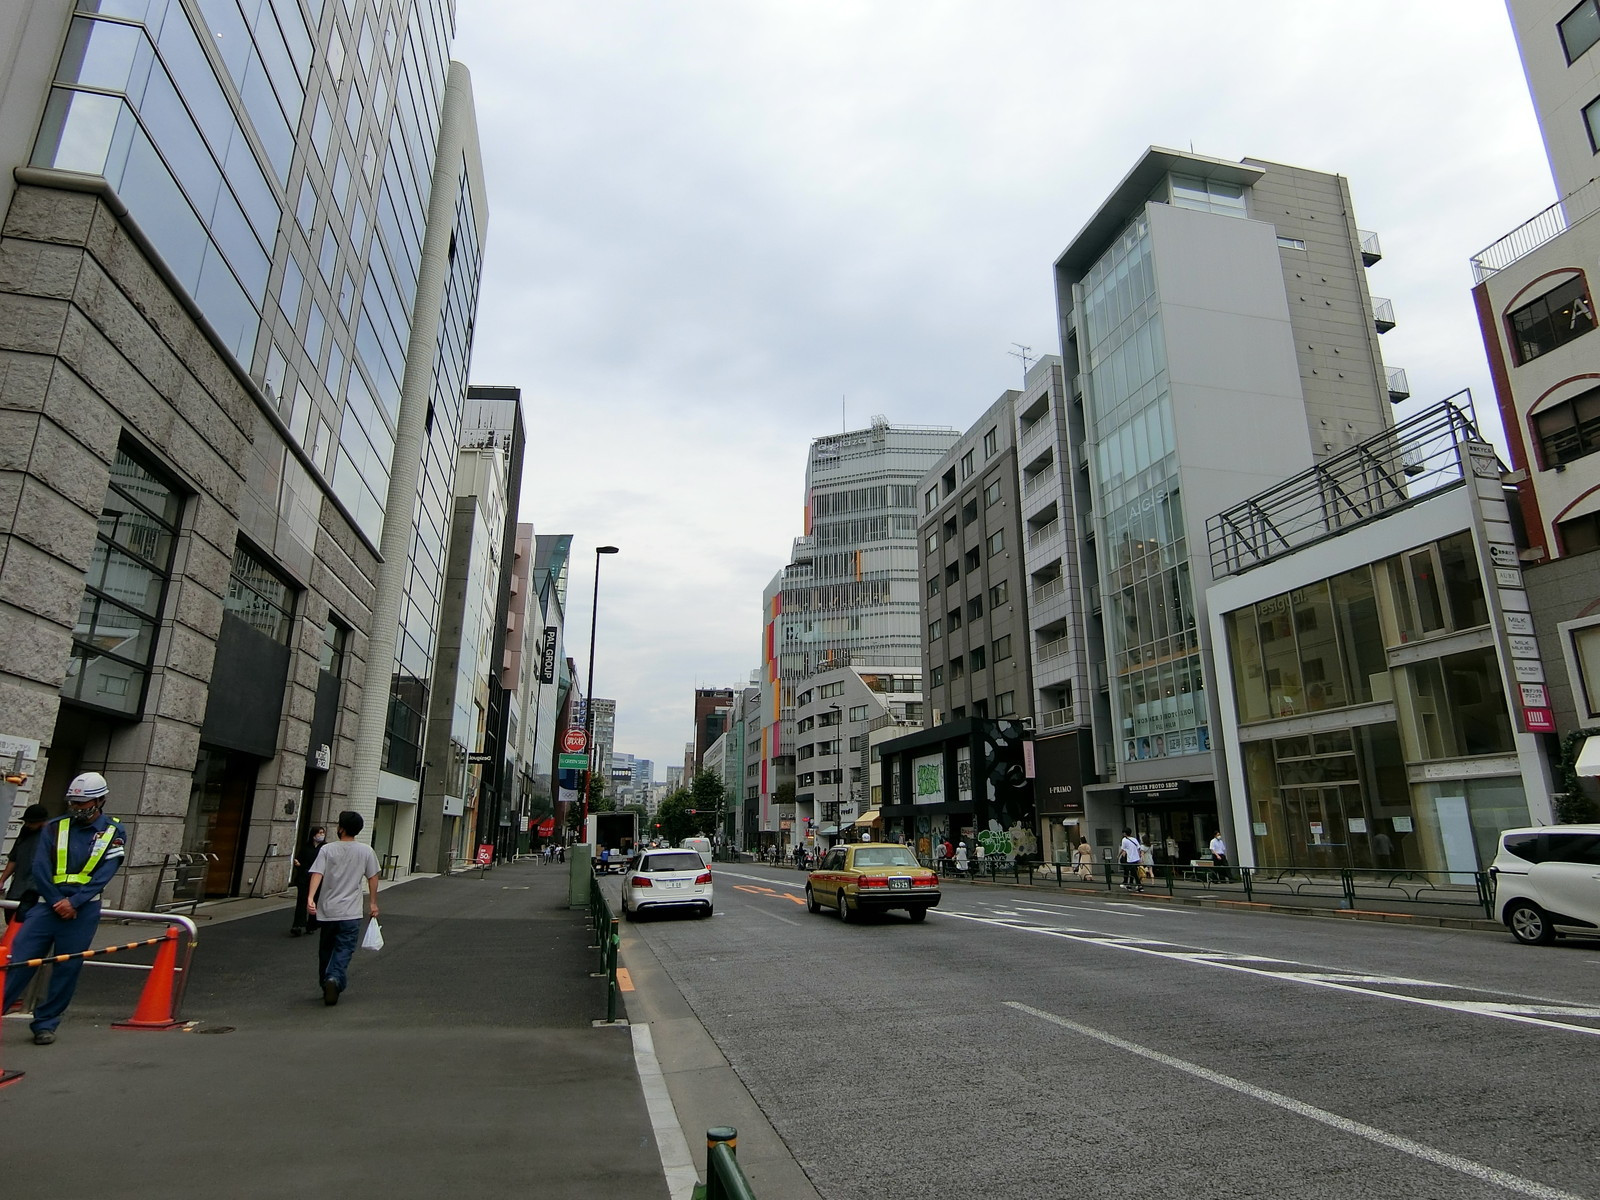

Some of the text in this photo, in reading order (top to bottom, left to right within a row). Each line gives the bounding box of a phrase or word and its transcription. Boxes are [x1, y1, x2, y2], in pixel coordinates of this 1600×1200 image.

[1507, 616, 1526, 624] MILK
[544, 631, 555, 679] PAL GROUP
[566, 736, 585, 746] 消火栓
[1049, 785, 1072, 794] I-PRIMO
[1148, 782, 1165, 790] PHOTO
